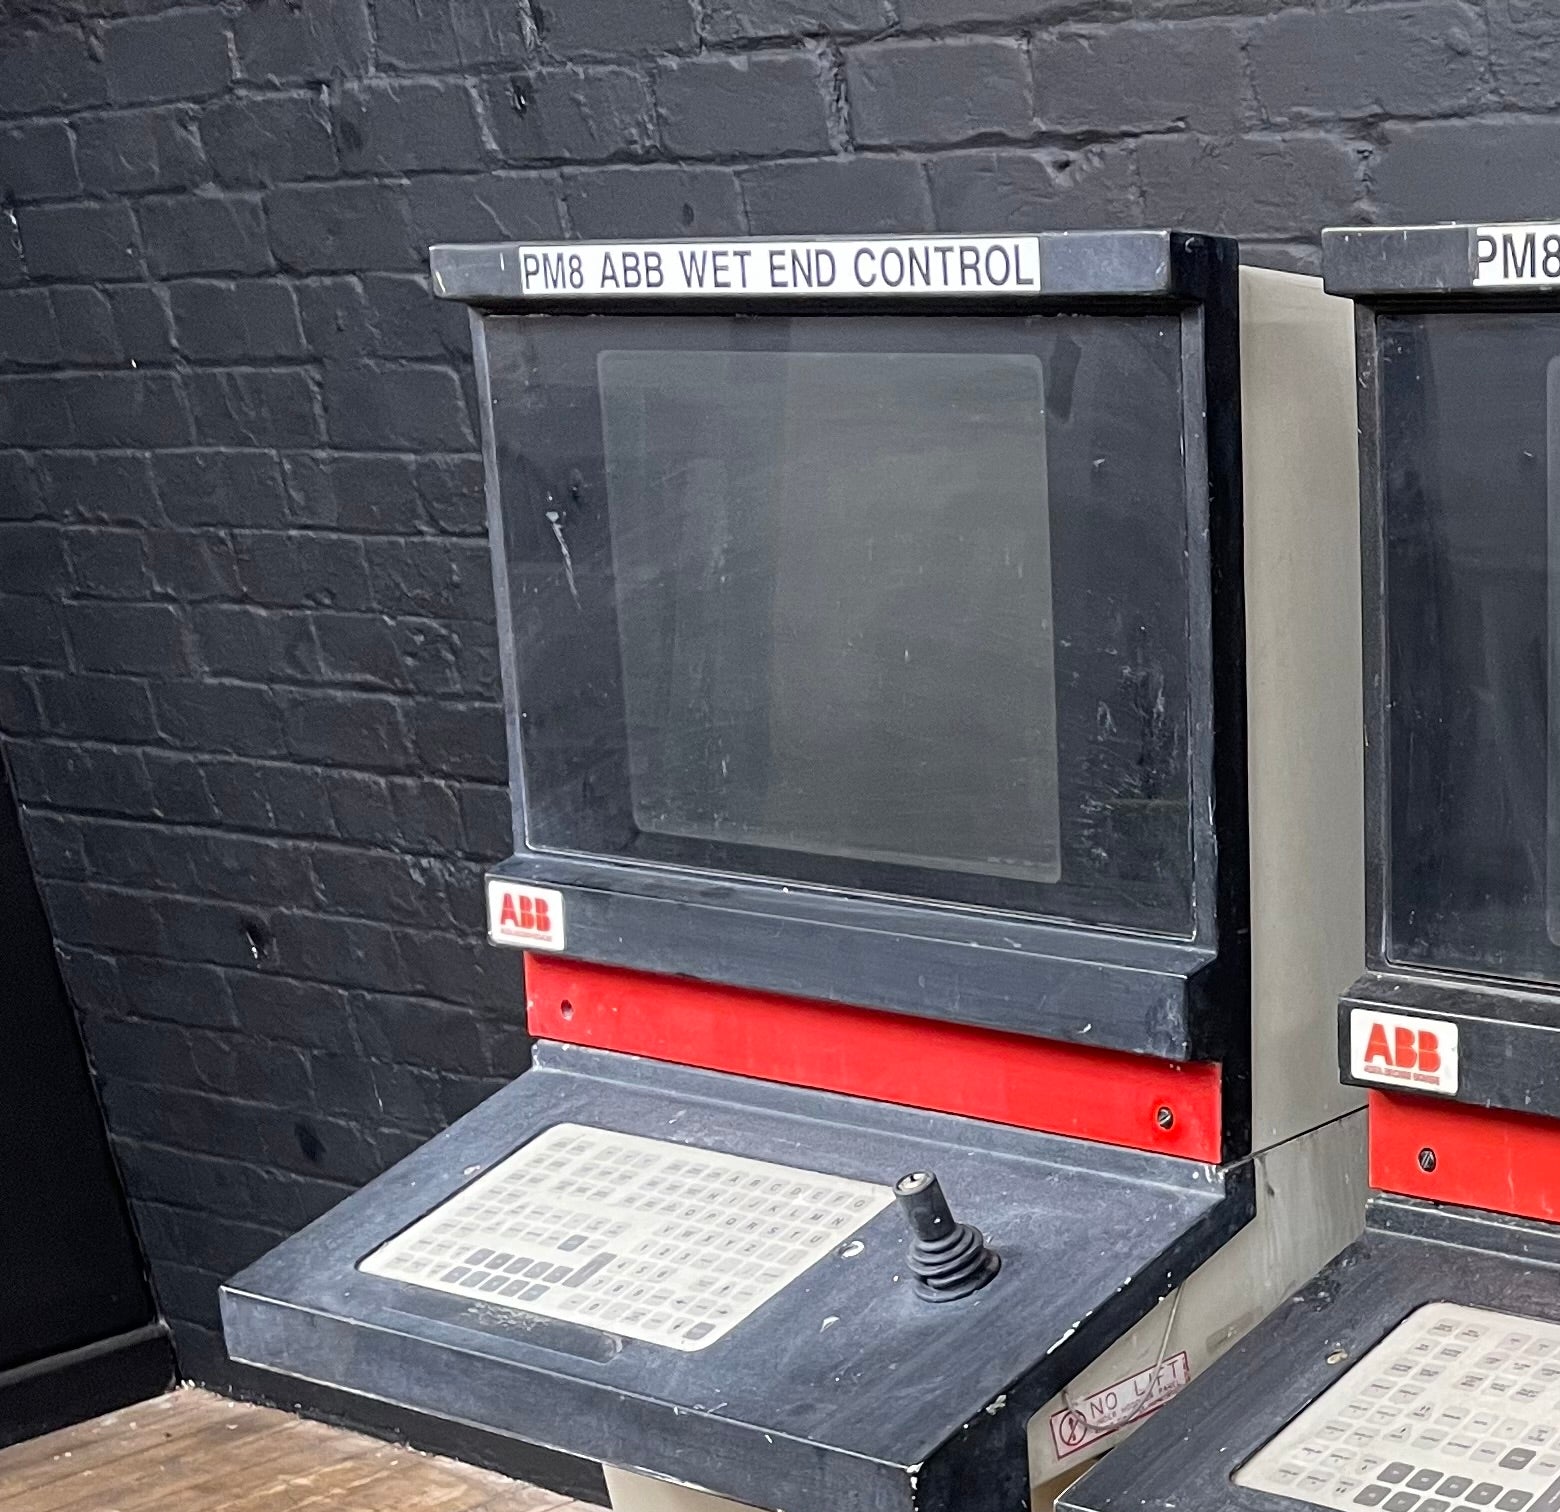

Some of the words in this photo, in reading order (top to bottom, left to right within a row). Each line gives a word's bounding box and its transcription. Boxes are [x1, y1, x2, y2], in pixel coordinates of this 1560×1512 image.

[524, 253, 584, 290] PM8
[599, 251, 664, 289] ABB
[680, 249, 751, 289] WET
[769, 248, 837, 288] END
[853, 243, 1034, 288] CONTROL
[500, 893, 551, 932] ABB
[1364, 1023, 1441, 1073] ABB
[1089, 1392, 1118, 1418] NO
